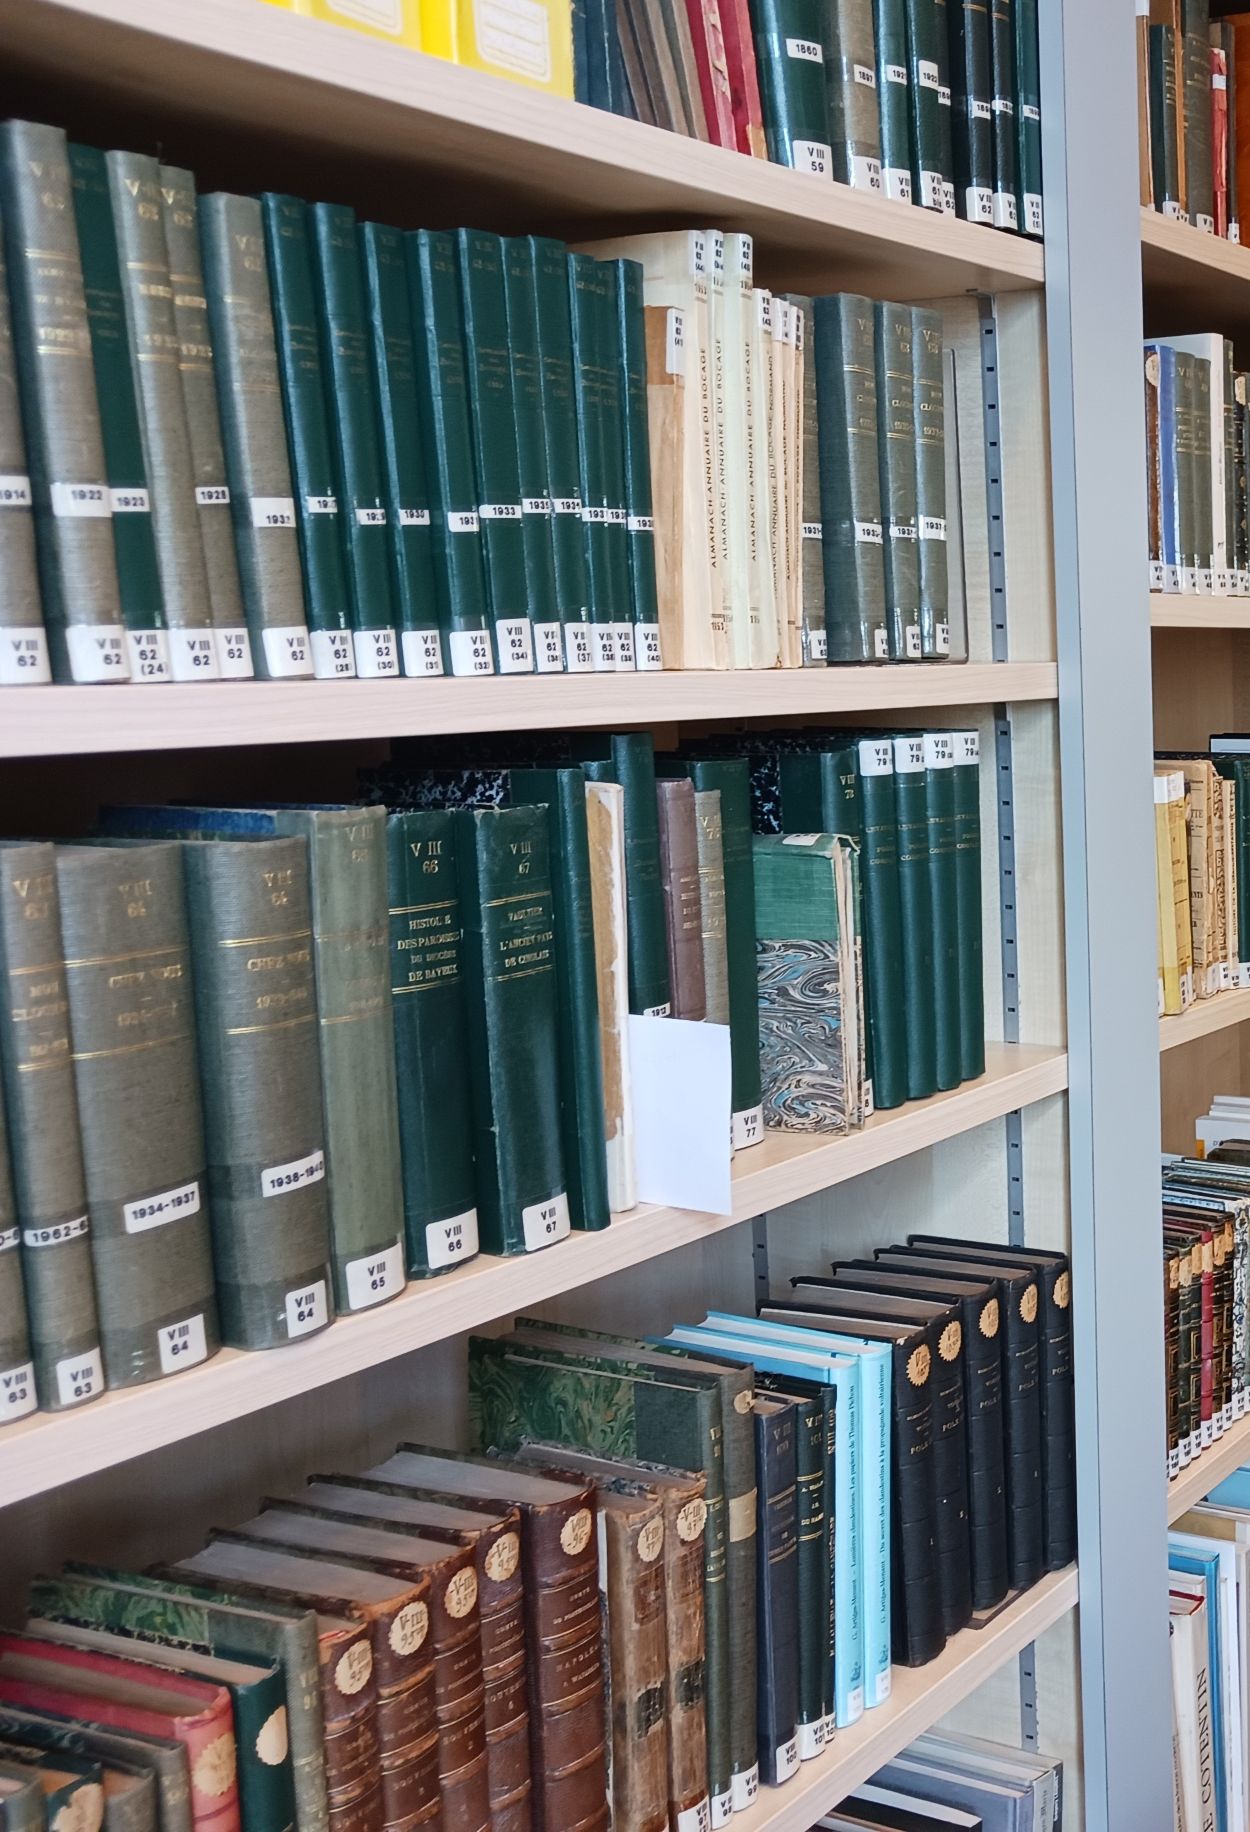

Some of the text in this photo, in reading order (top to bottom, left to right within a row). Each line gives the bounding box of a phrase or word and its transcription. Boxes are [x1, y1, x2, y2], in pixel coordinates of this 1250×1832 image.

[811, 161, 824, 172] 59
[870, 177, 880, 188] 60
[900, 187, 909, 198] 61
[715, 397, 724, 414] DU
[746, 400, 752, 416] DU
[700, 348, 717, 568] ALMANACH ANNUAIRE DU BOCAGE
[718, 422, 726, 485] ANNUAIRE
[493, 507, 515, 515] 1933
[720, 492, 728, 560] ALMANACH
[749, 494, 757, 562] ALMANACH
[510, 639, 522, 647] 62
[546, 643, 556, 651] 62
[576, 643, 587, 651] 62
[602, 644, 612, 652] 62
[620, 643, 630, 651] 62
[647, 643, 658, 651] 62
[139, 649, 157, 661] 62
[227, 648, 243, 659] 62
[291, 650, 305, 661] 62
[334, 649, 347, 659] 62
[376, 647, 390, 656] 62
[425, 648, 437, 657] 62
[473, 648, 486, 657] 62
[17, 655, 37, 667] 62
[103, 653, 122, 665] 62
[193, 655, 210, 666] 62
[936, 751, 945, 759] 79
[965, 748, 973, 756] 79
[910, 755, 920, 763] 79
[411, 843, 421, 856] V
[422, 859, 439, 873] 66
[518, 862, 530, 874] 67
[409, 971, 423, 982] DE
[746, 1127, 756, 1138] 77
[545, 1221, 557, 1233] 67
[448, 1239, 462, 1252] 66
[371, 1277, 385, 1290] 65
[297, 1308, 314, 1322] 64
[171, 1340, 189, 1355] 64
[8, 1388, 27, 1403] 63
[74, 1383, 92, 1397] 63
[1197, 1668, 1212, 1804] COTENTIN
